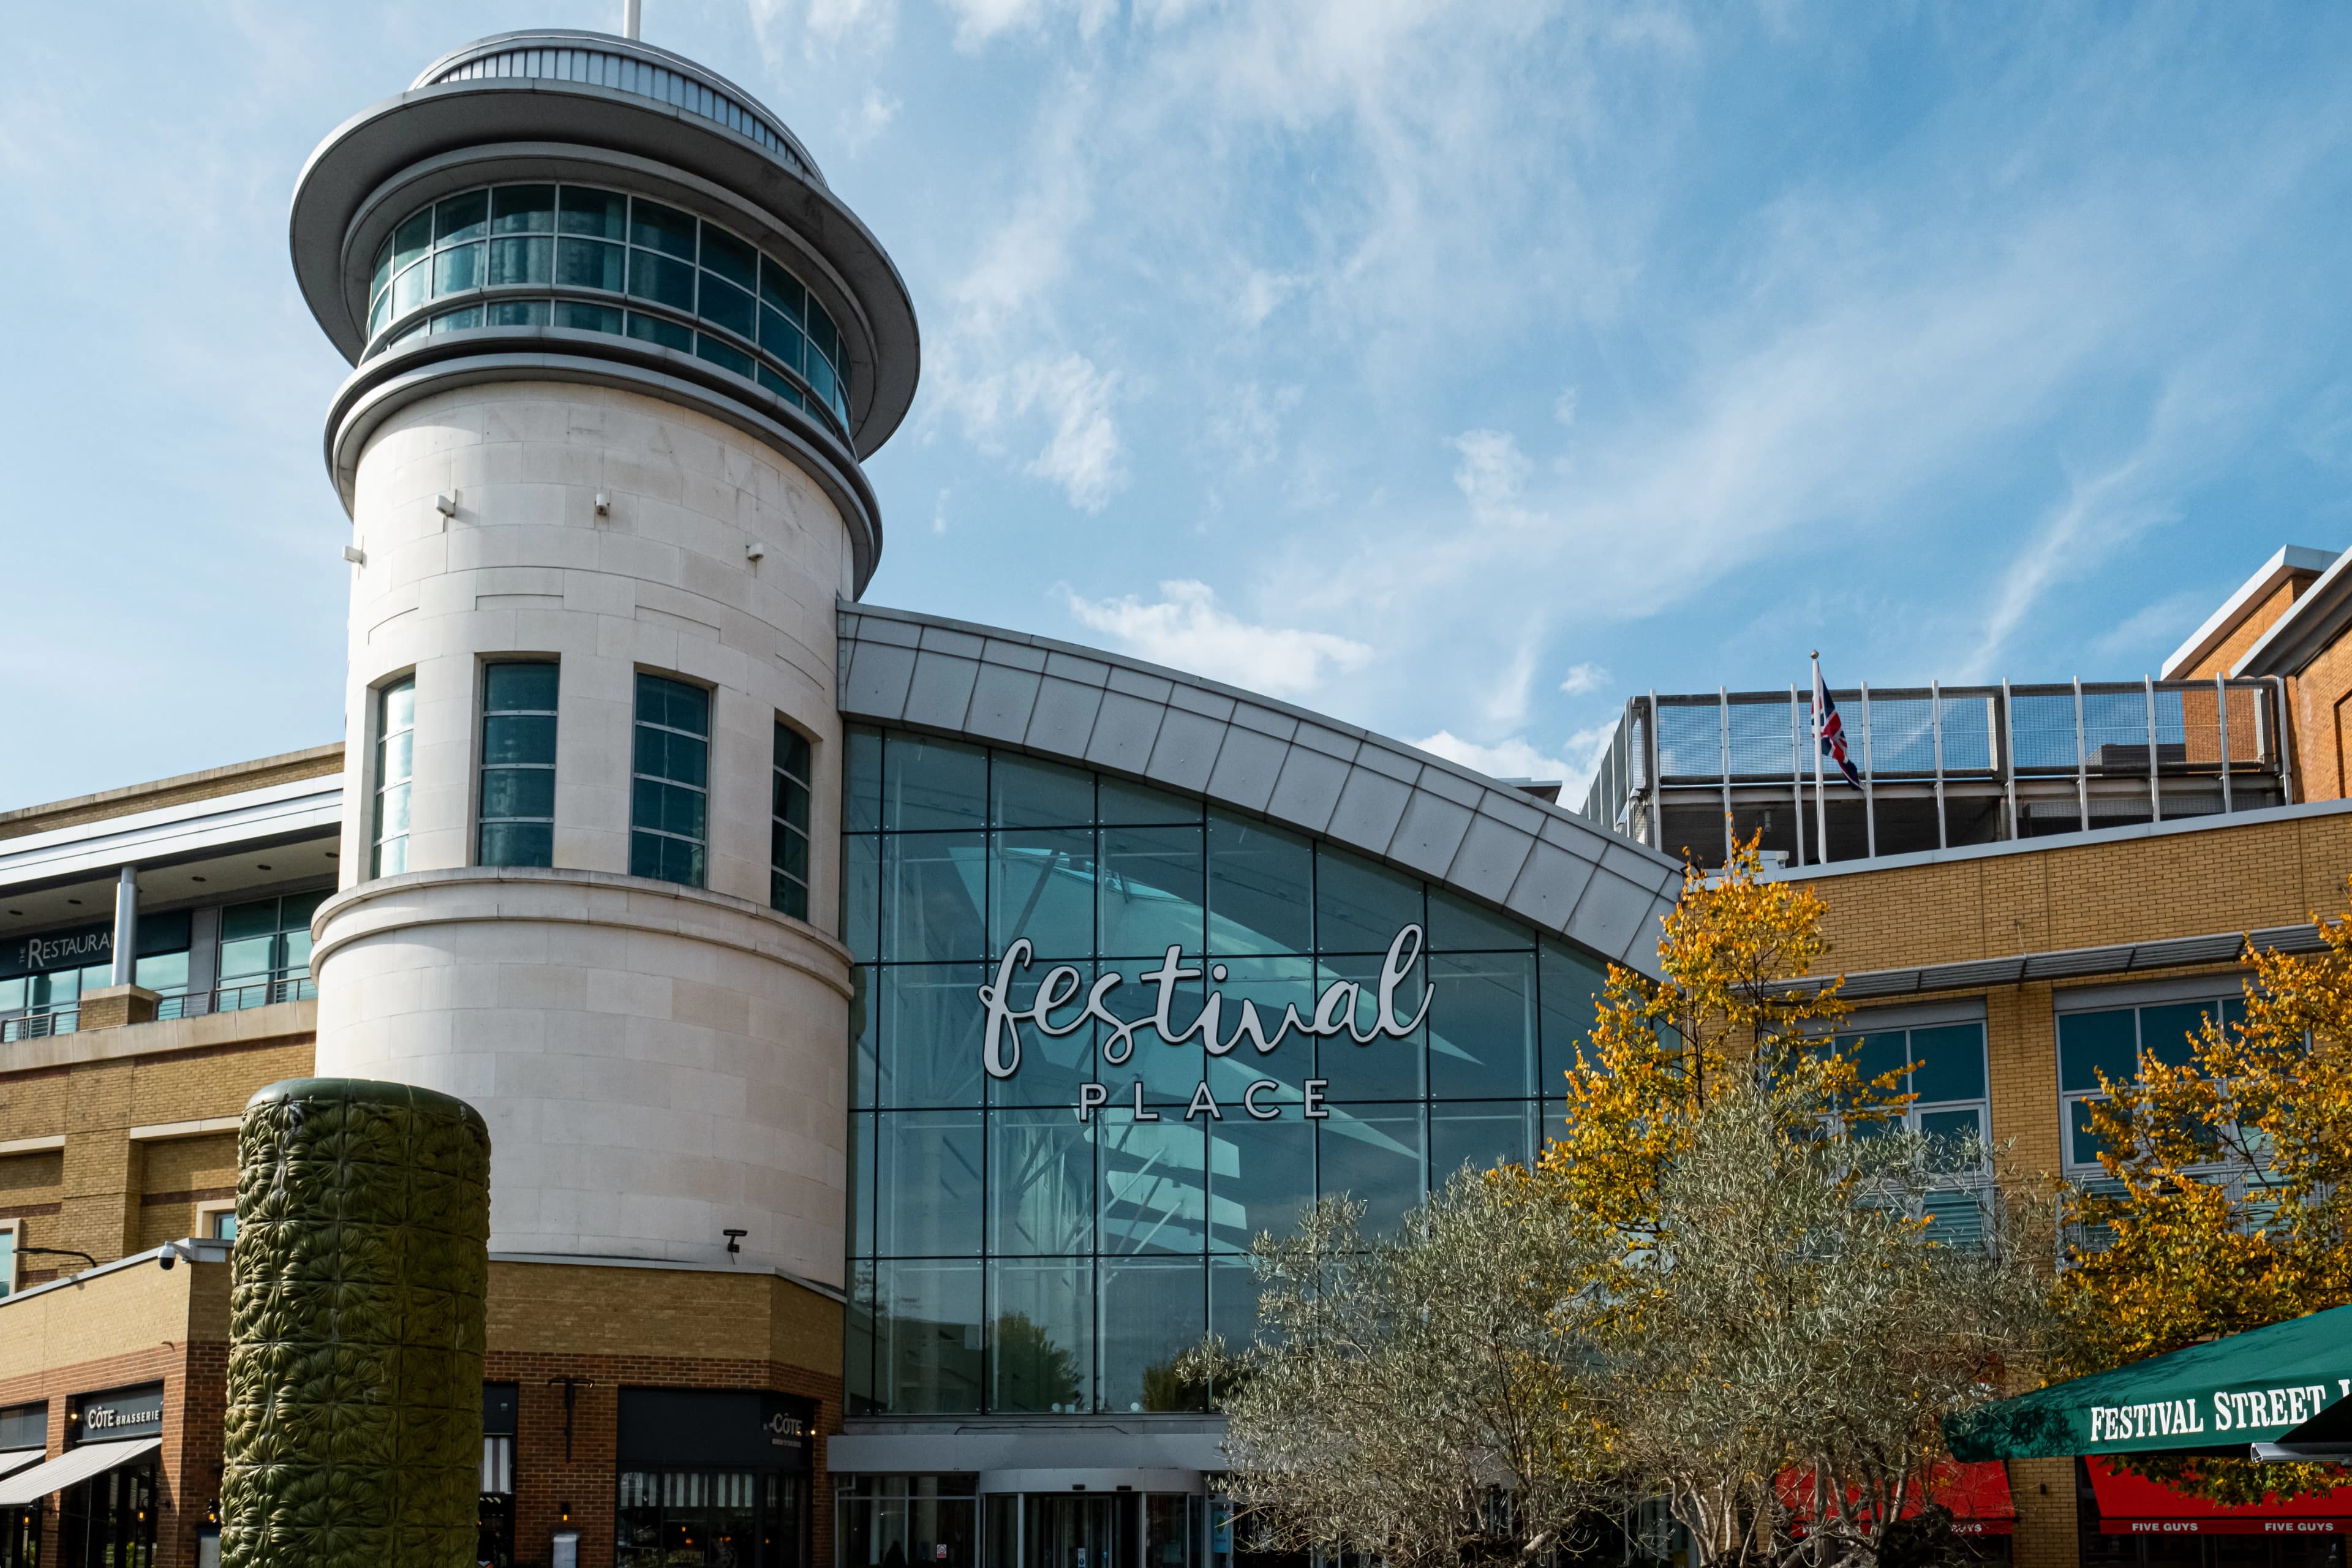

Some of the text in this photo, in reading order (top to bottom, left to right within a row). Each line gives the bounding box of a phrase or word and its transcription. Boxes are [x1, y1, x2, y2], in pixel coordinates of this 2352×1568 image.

[978, 923, 1435, 1078] festival
[1079, 1079, 1330, 1122] PLACE
[88, 1406, 159, 1429] CÔTE BRASSERIE
[772, 1412, 802, 1436] CÔTE
[2090, 1398, 2204, 1442] FESTIVAL
[2214, 1384, 2326, 1431] STREET
[2132, 1523, 2198, 1531] FIVE GUYS
[2264, 1523, 2334, 1531] FIVE GUYS
